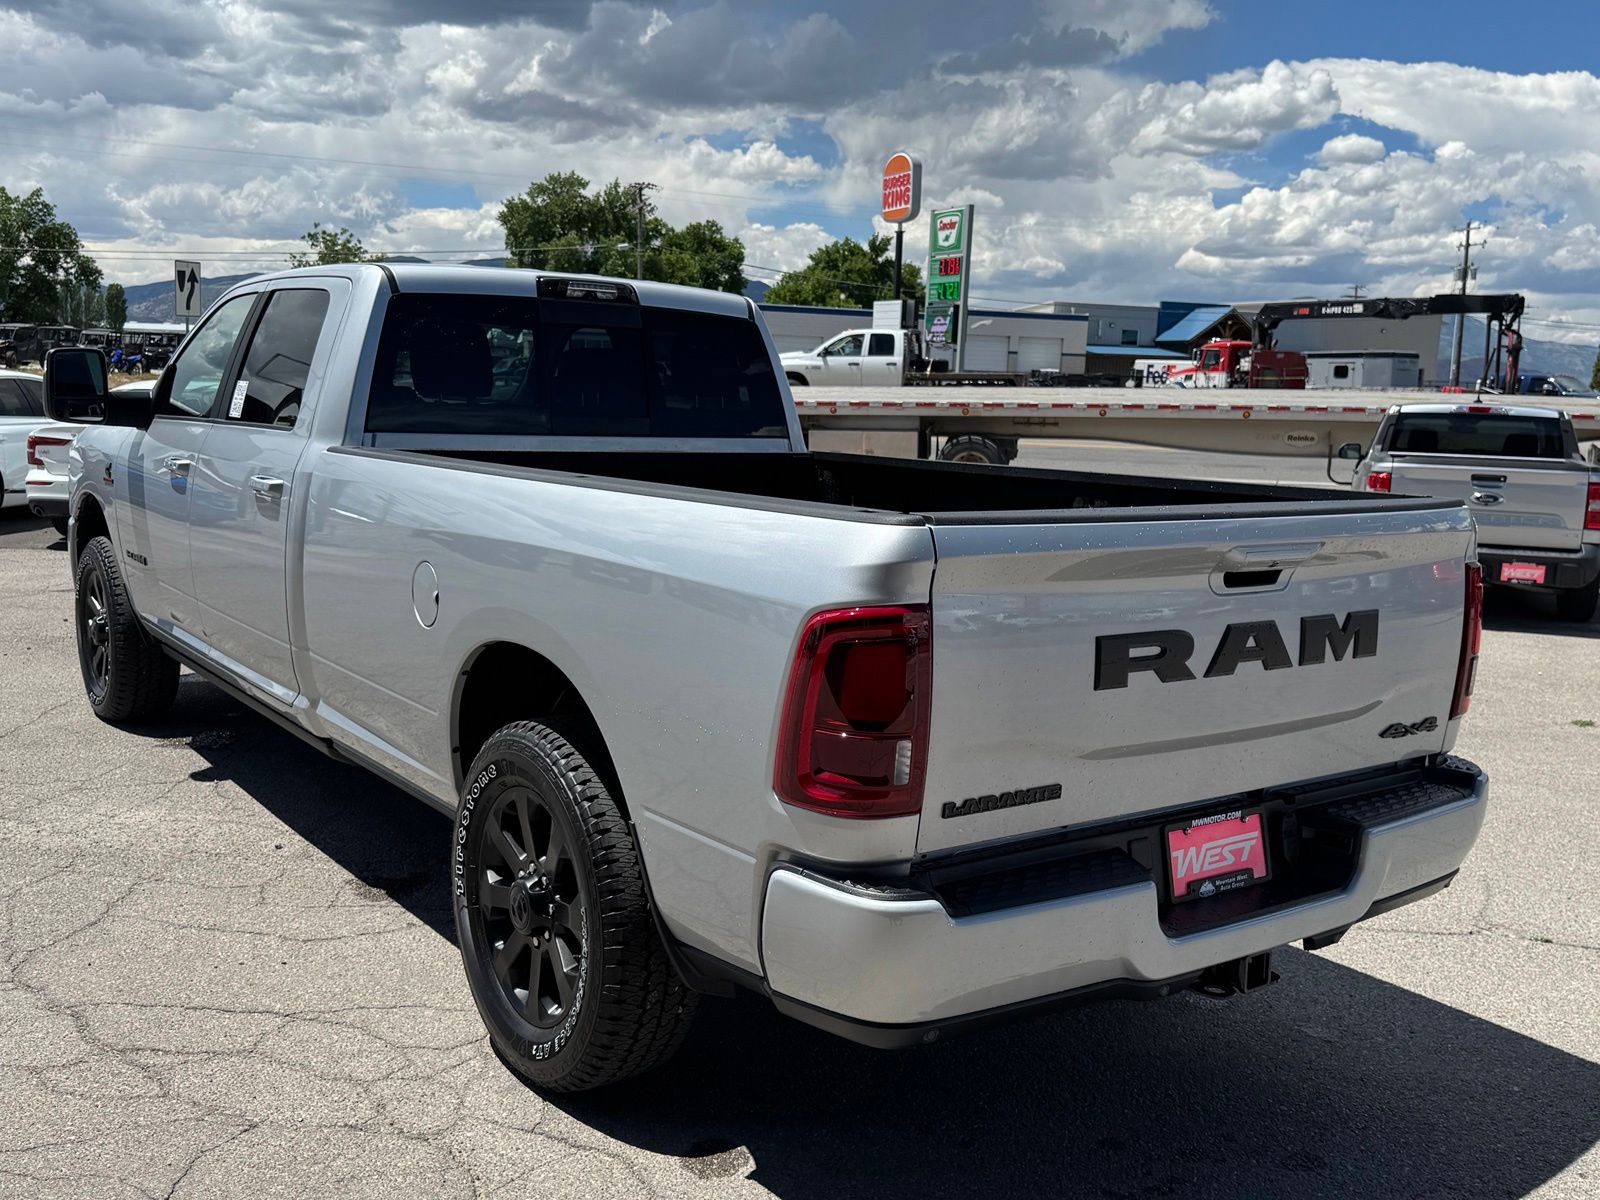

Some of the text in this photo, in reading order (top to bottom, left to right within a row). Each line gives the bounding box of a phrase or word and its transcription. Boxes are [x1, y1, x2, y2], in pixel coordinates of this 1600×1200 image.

[883, 172, 911, 191] BURGER
[882, 186, 910, 210] KING
[1146, 364, 1177, 385] Fed
[1286, 434, 1315, 442] Reinke
[1093, 609, 1379, 692] RAM
[941, 783, 1062, 819] LARAMIE
[455, 764, 497, 896] Firestone
[1191, 810, 1242, 828] MWMOTOR.COM
[1172, 831, 1259, 879] WEST
